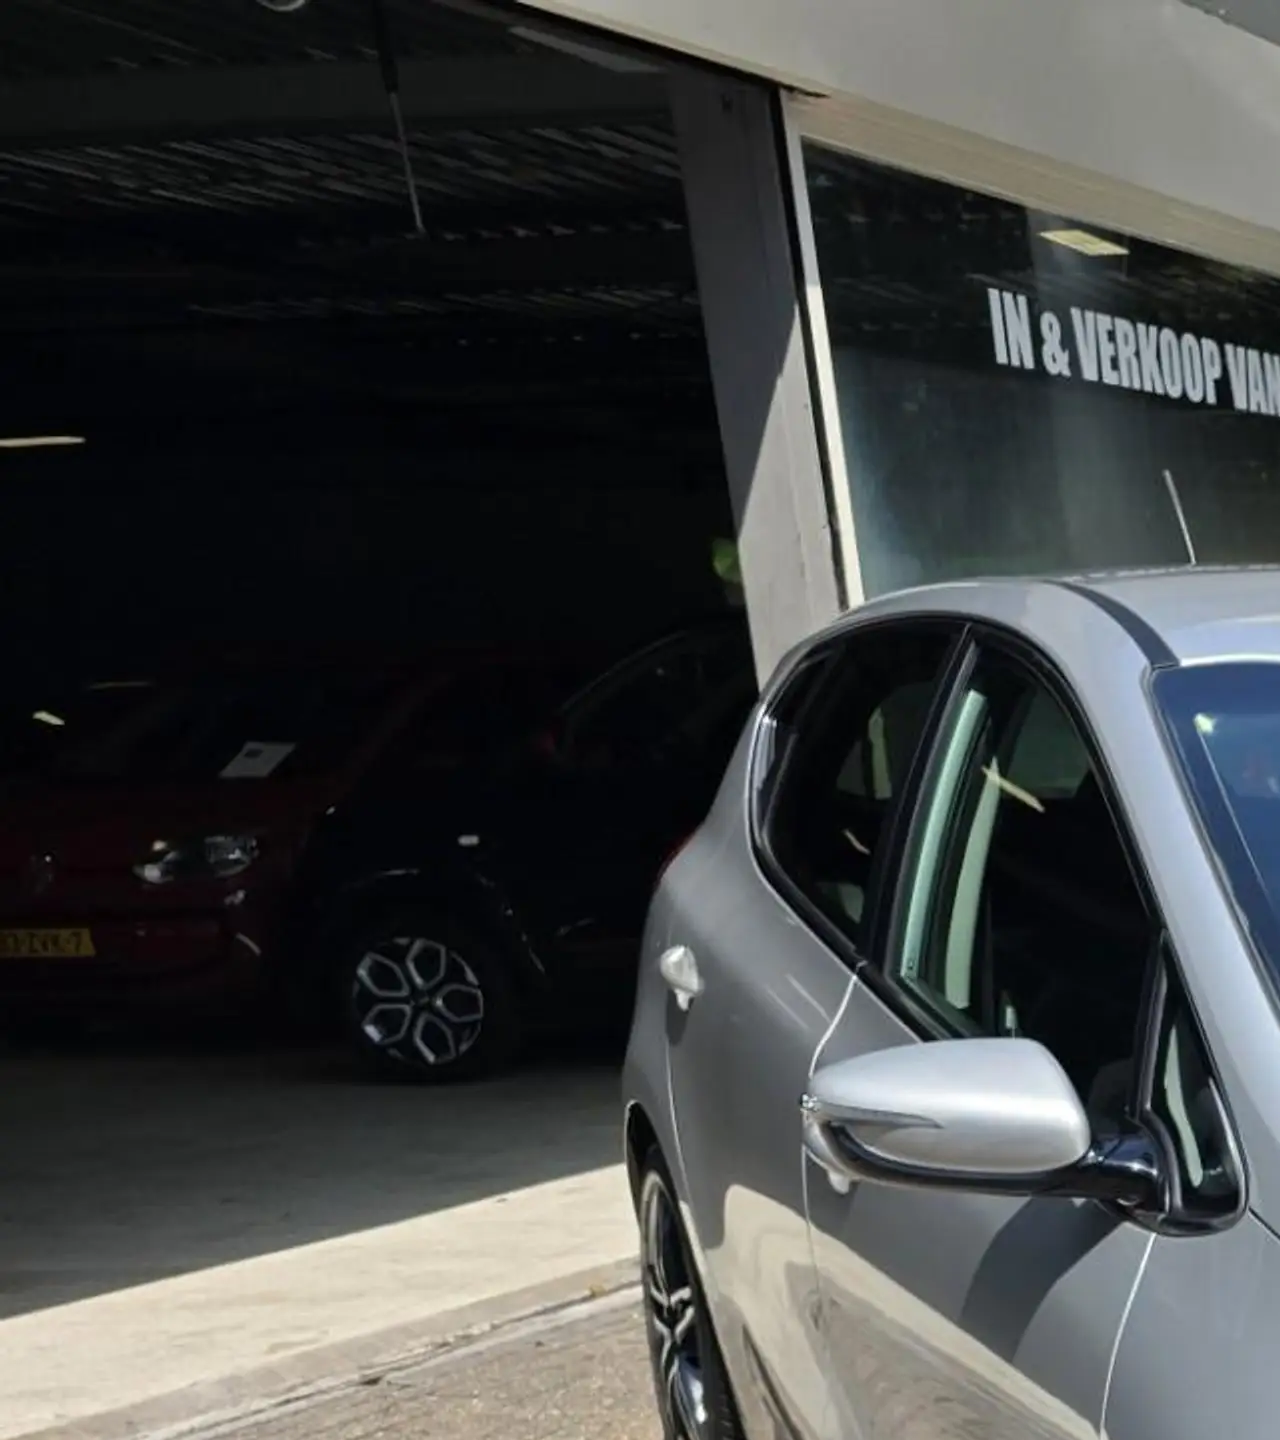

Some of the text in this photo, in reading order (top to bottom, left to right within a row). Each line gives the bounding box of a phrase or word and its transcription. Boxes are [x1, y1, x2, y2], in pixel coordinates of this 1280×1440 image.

[988, 288, 1034, 369] IN
[1040, 312, 1070, 377] &
[1070, 306, 1221, 404] VERKOOP
